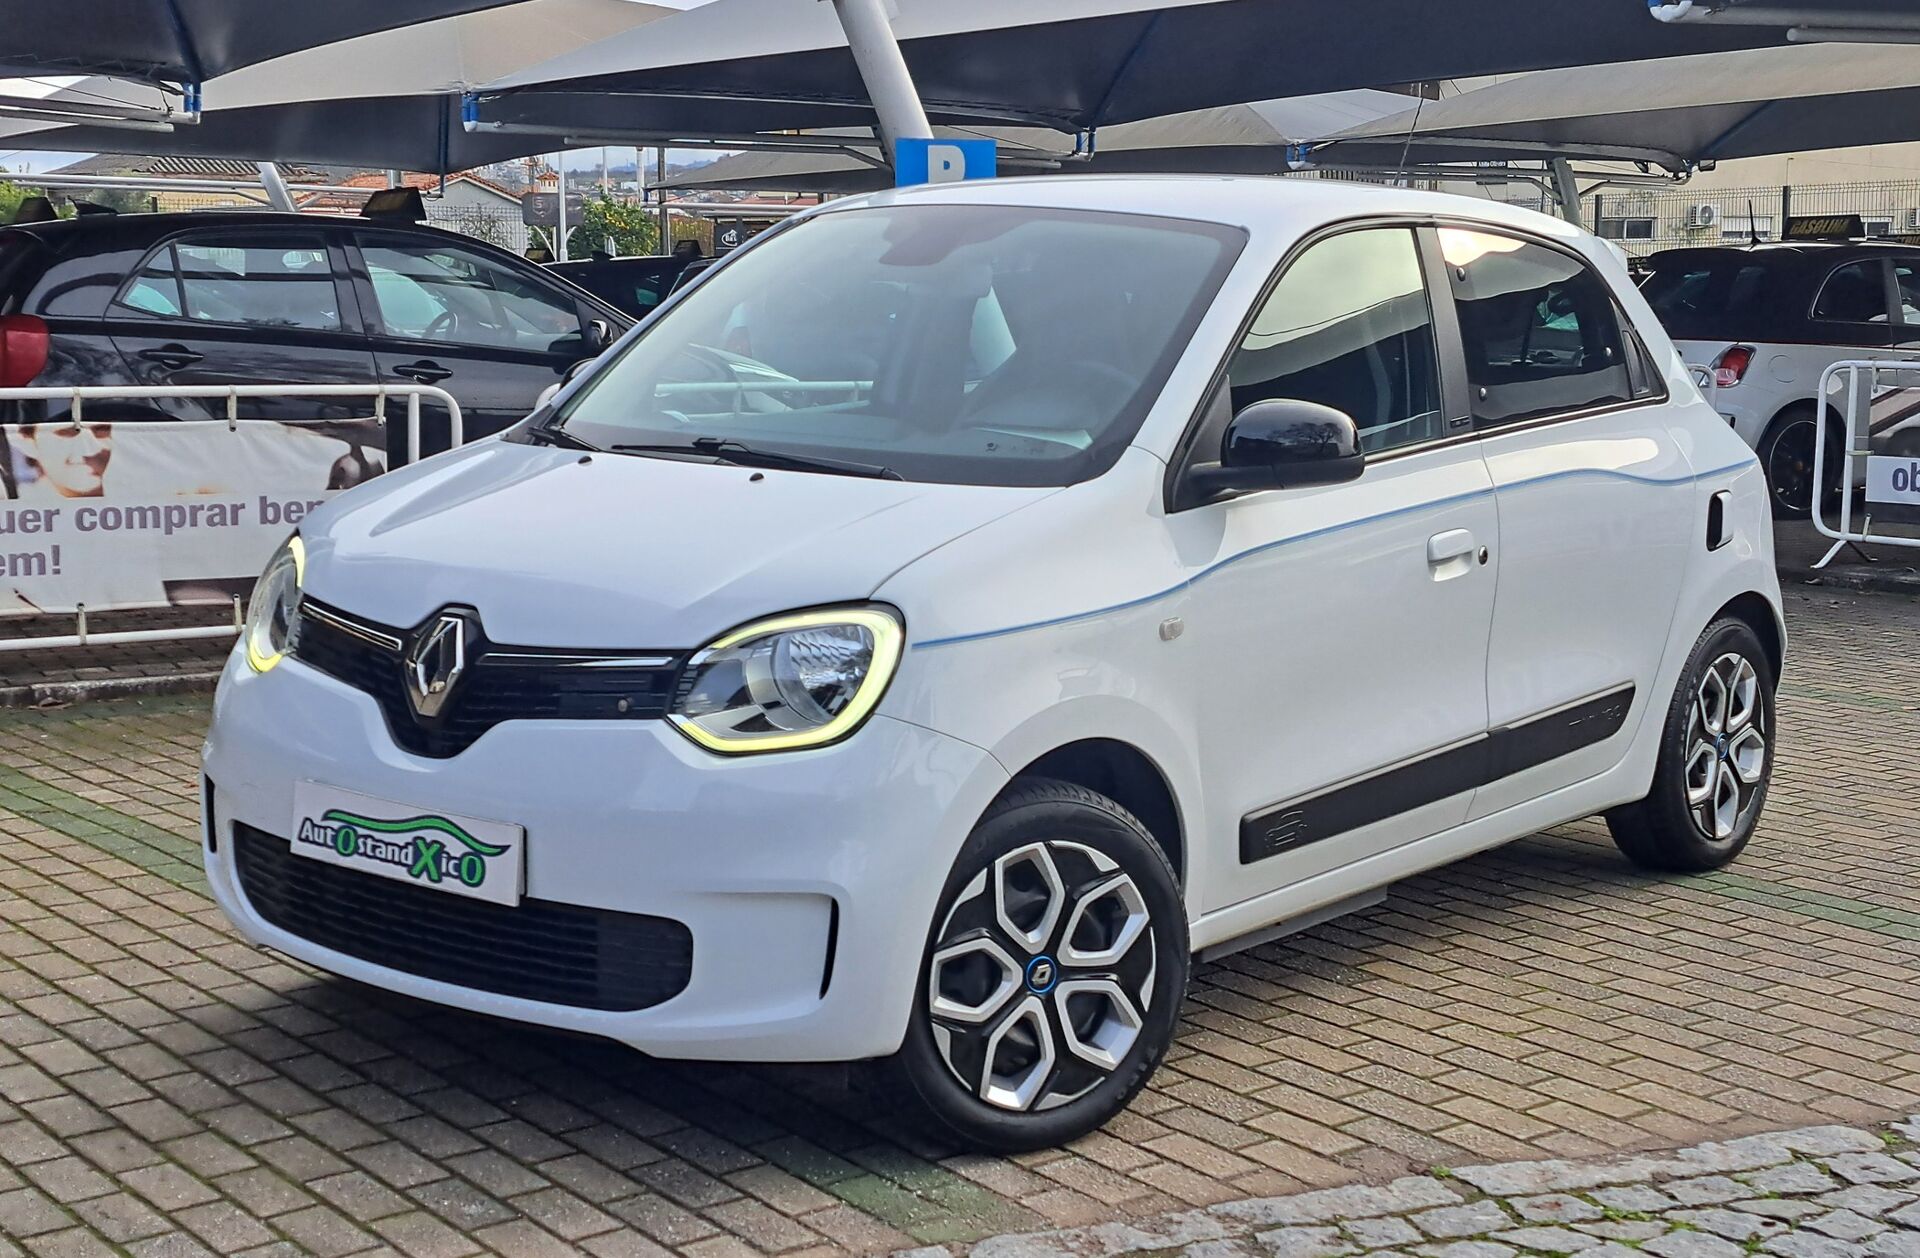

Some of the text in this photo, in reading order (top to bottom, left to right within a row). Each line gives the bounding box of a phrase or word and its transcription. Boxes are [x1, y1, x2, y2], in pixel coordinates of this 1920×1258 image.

[928, 145, 966, 184] P
[74, 502, 246, 535] comprar
[0, 544, 61, 577] m!
